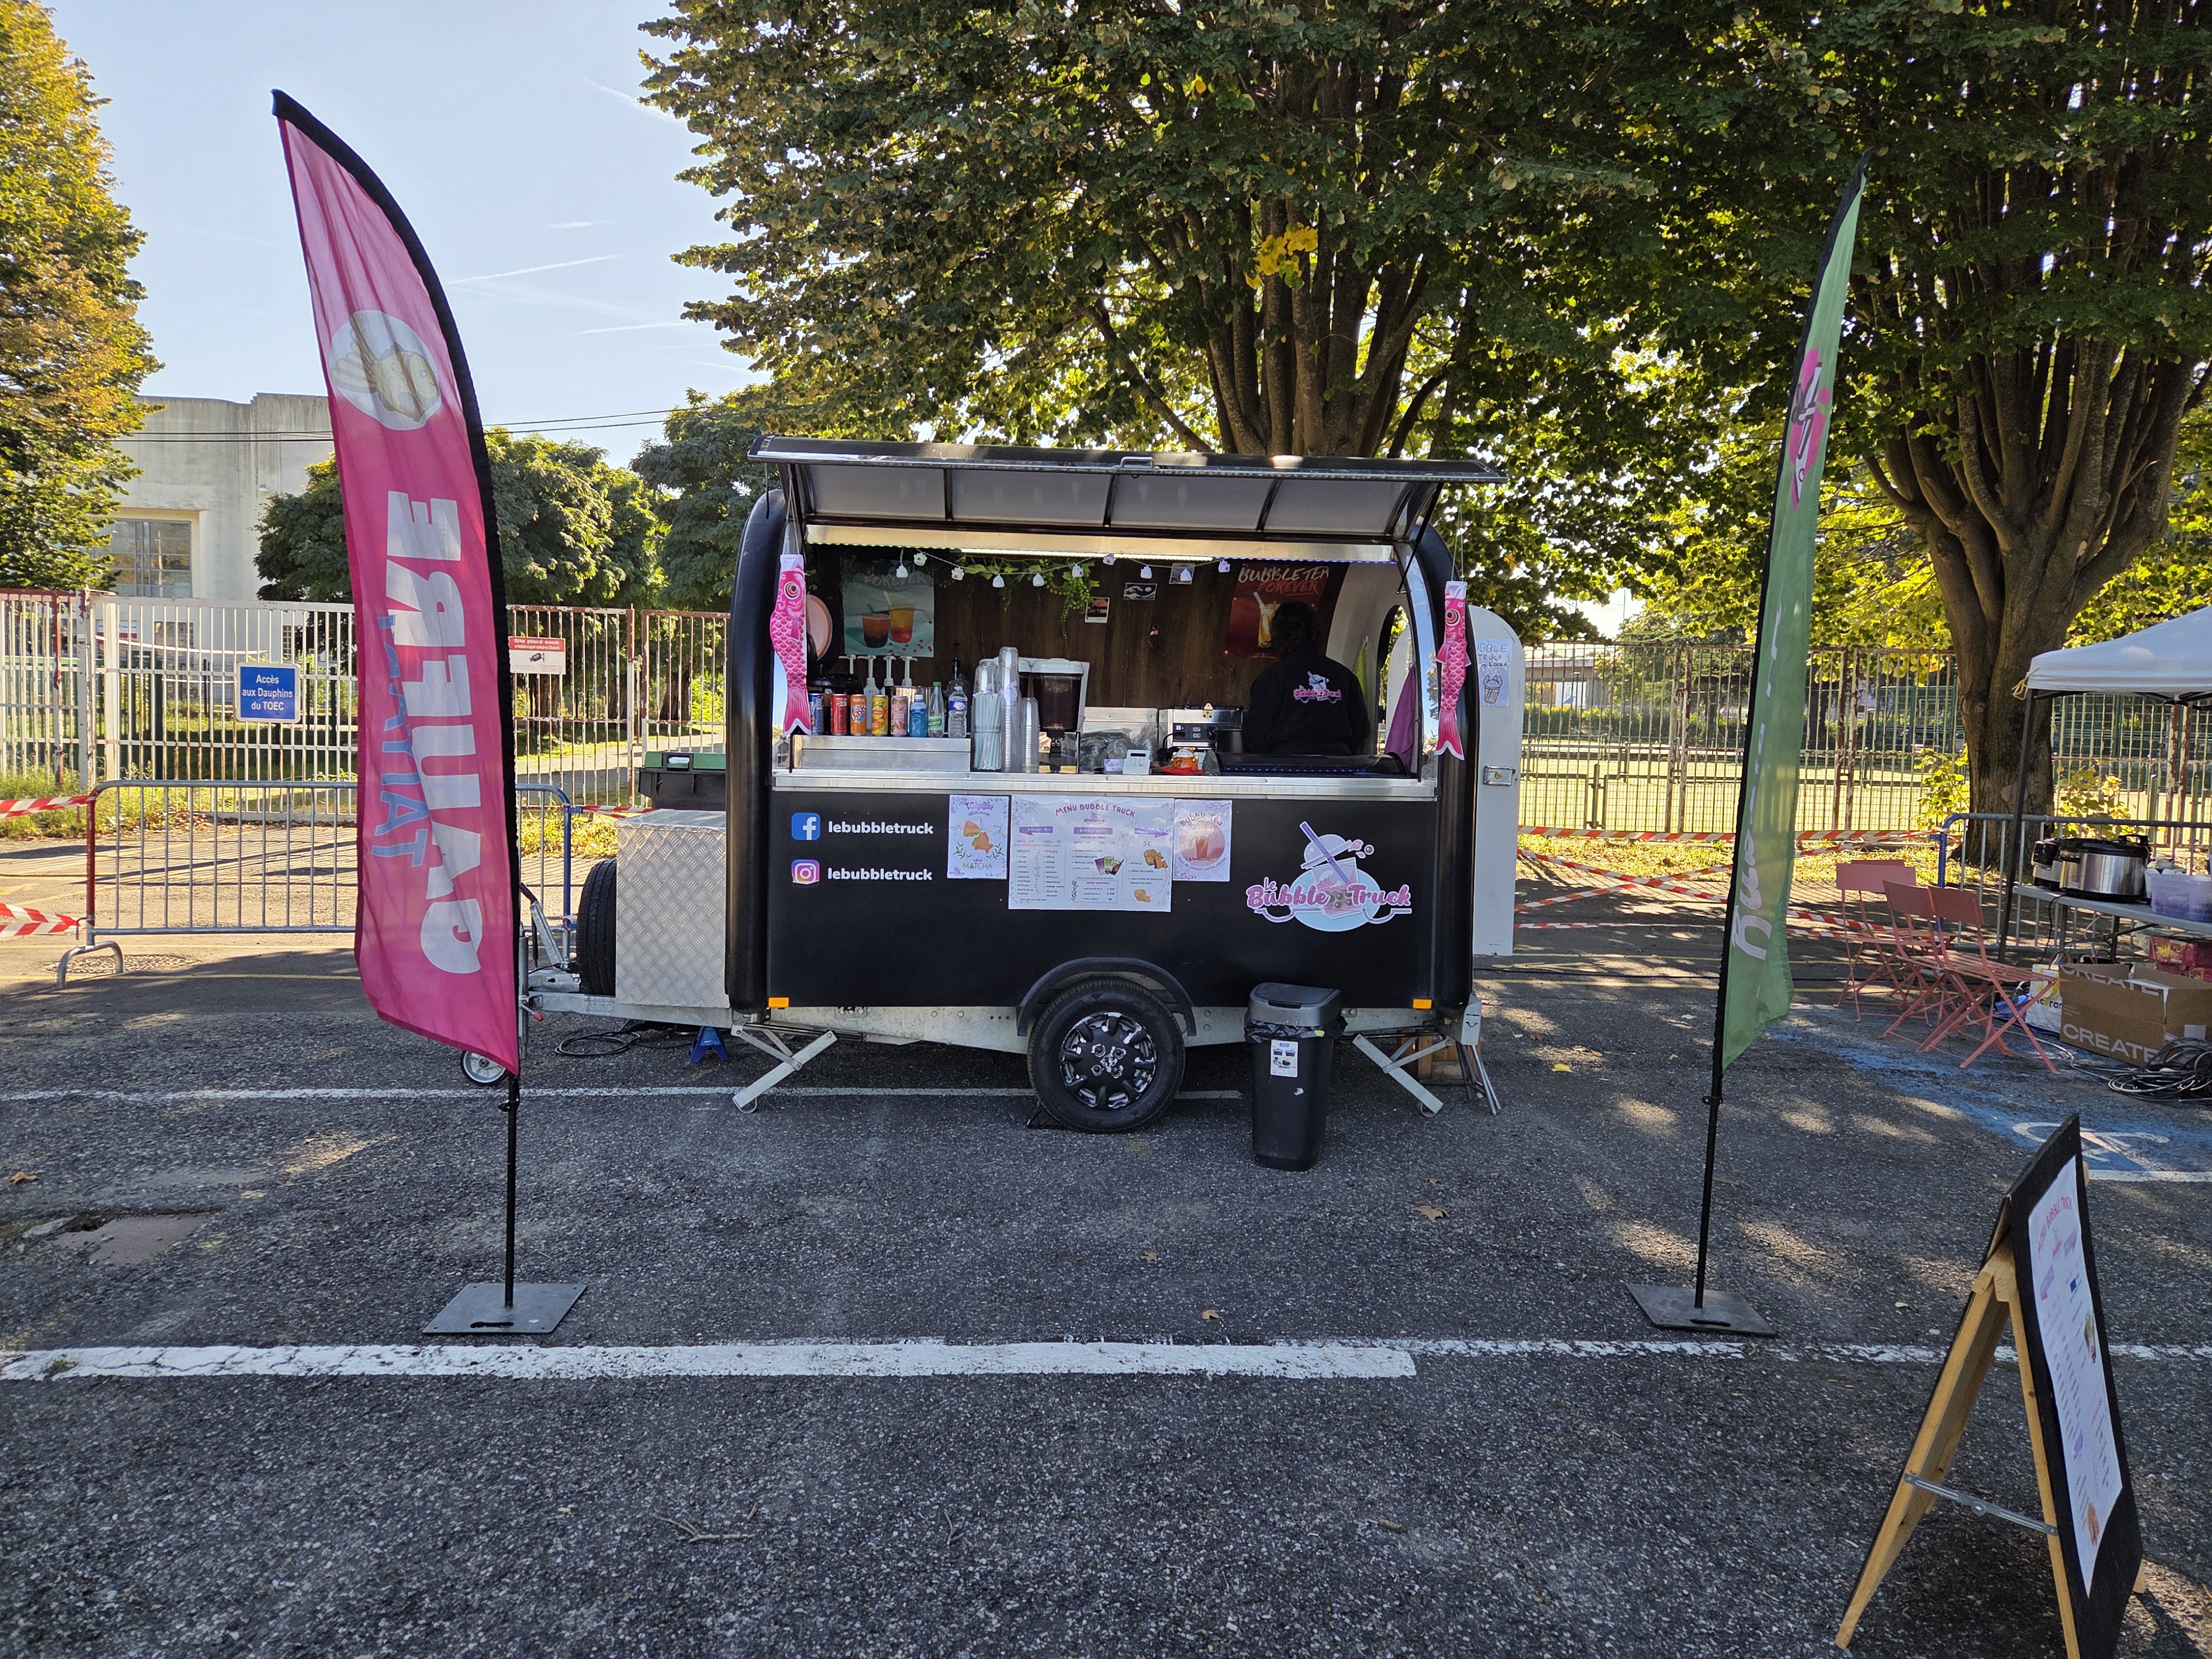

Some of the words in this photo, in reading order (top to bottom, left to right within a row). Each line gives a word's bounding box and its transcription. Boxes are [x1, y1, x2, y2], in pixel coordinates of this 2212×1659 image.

[864, 572, 927, 588] FOREVER
[1238, 566, 1303, 583] BUBBLE
[1258, 580, 1320, 596] FOREVER
[256, 674, 279, 684] Accès
[258, 688, 293, 699] Dauphins
[251, 701, 261, 710] du
[263, 701, 284, 711] TOEC
[851, 705, 866, 721] Oasis
[1056, 804, 1077, 816] MENU
[1079, 803, 1110, 811] BUBBLE
[1112, 805, 1135, 818] TRUCK
[1180, 812, 1208, 827] Bubble
[1210, 813, 1223, 827] Tea
[828, 821, 933, 834] lebubbletruck
[828, 868, 932, 880] lebubbletruck
[1264, 877, 1277, 891] le
[1246, 884, 1330, 908] Bubble
[1347, 884, 1411, 906] Truck
[2063, 1023, 2161, 1065] CREATE
